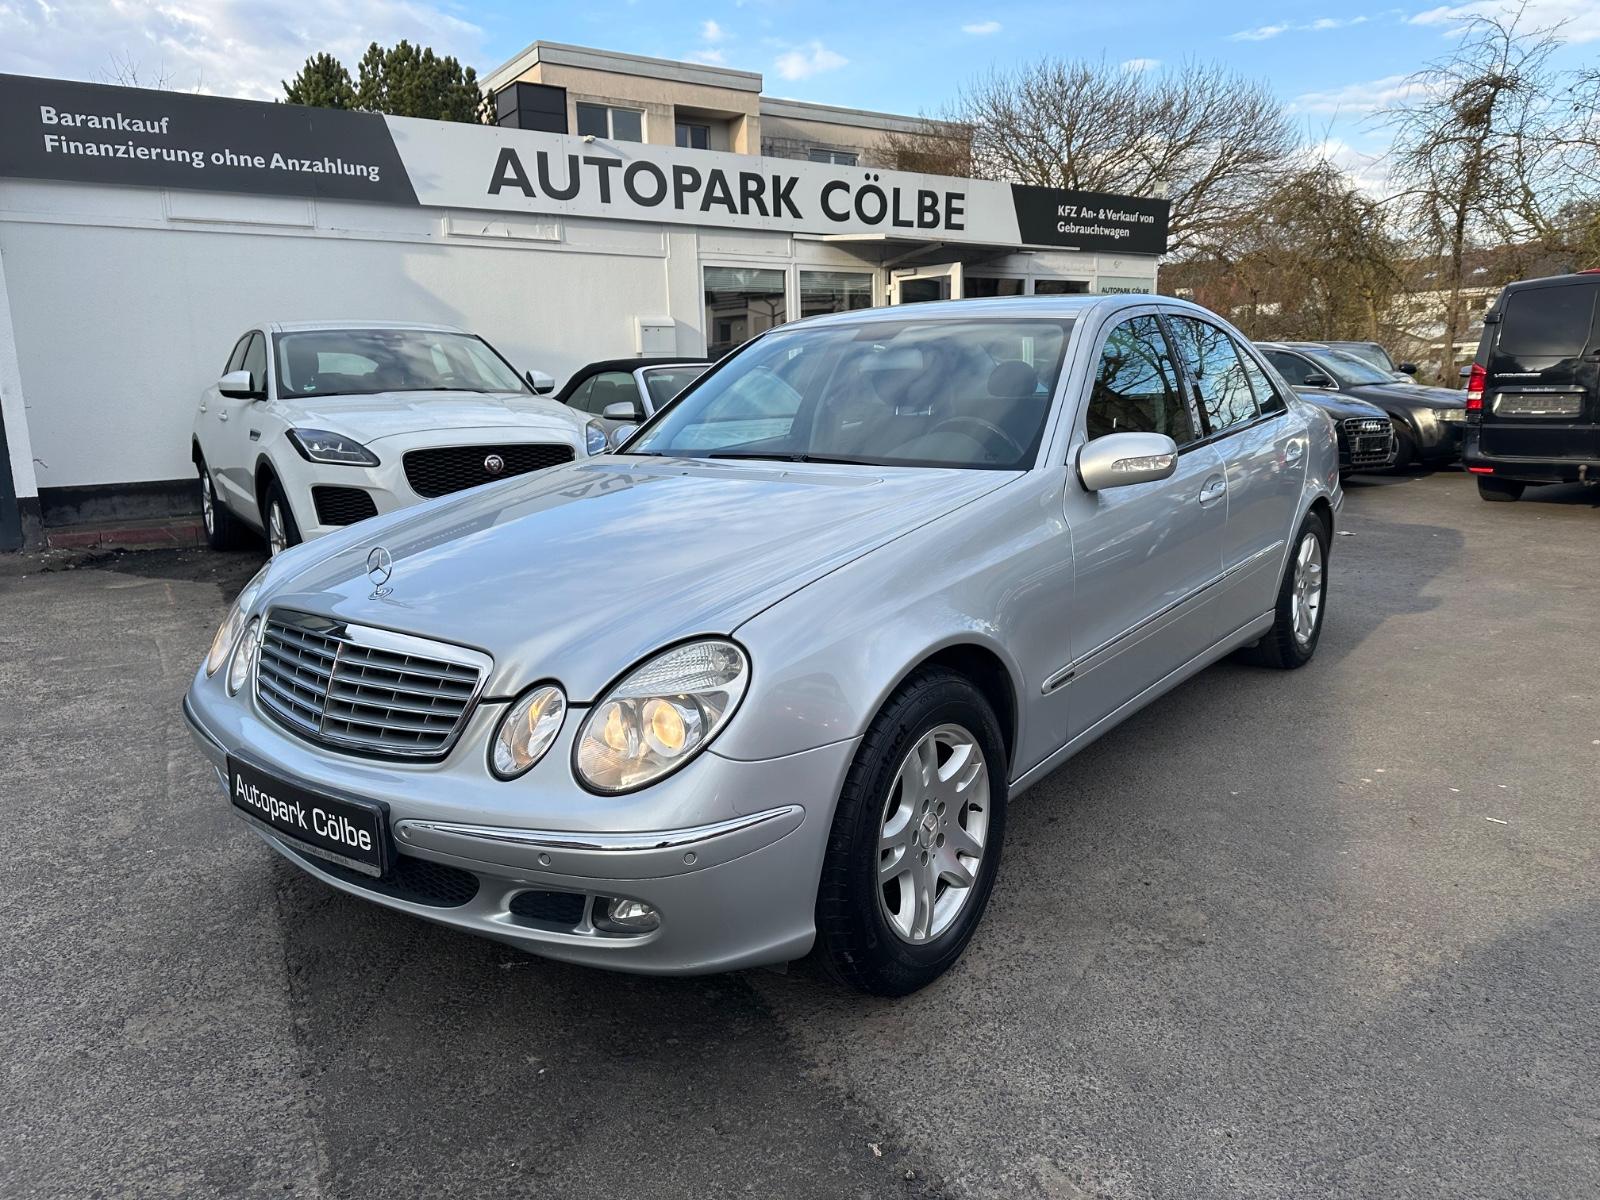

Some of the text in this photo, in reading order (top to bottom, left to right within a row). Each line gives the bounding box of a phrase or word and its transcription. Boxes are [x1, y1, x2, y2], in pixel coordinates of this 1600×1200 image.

[39, 105, 170, 134] Barankauf
[44, 134, 380, 182] Finanzierung ohne Anzahlung
[487, 147, 966, 231] AUTOPARK CÖLBE
[1057, 205, 1155, 224] KFZ An- & Verkauf von
[1057, 221, 1130, 239] Gebrauchtwagen
[235, 773, 372, 851] Autopark Cölbe
